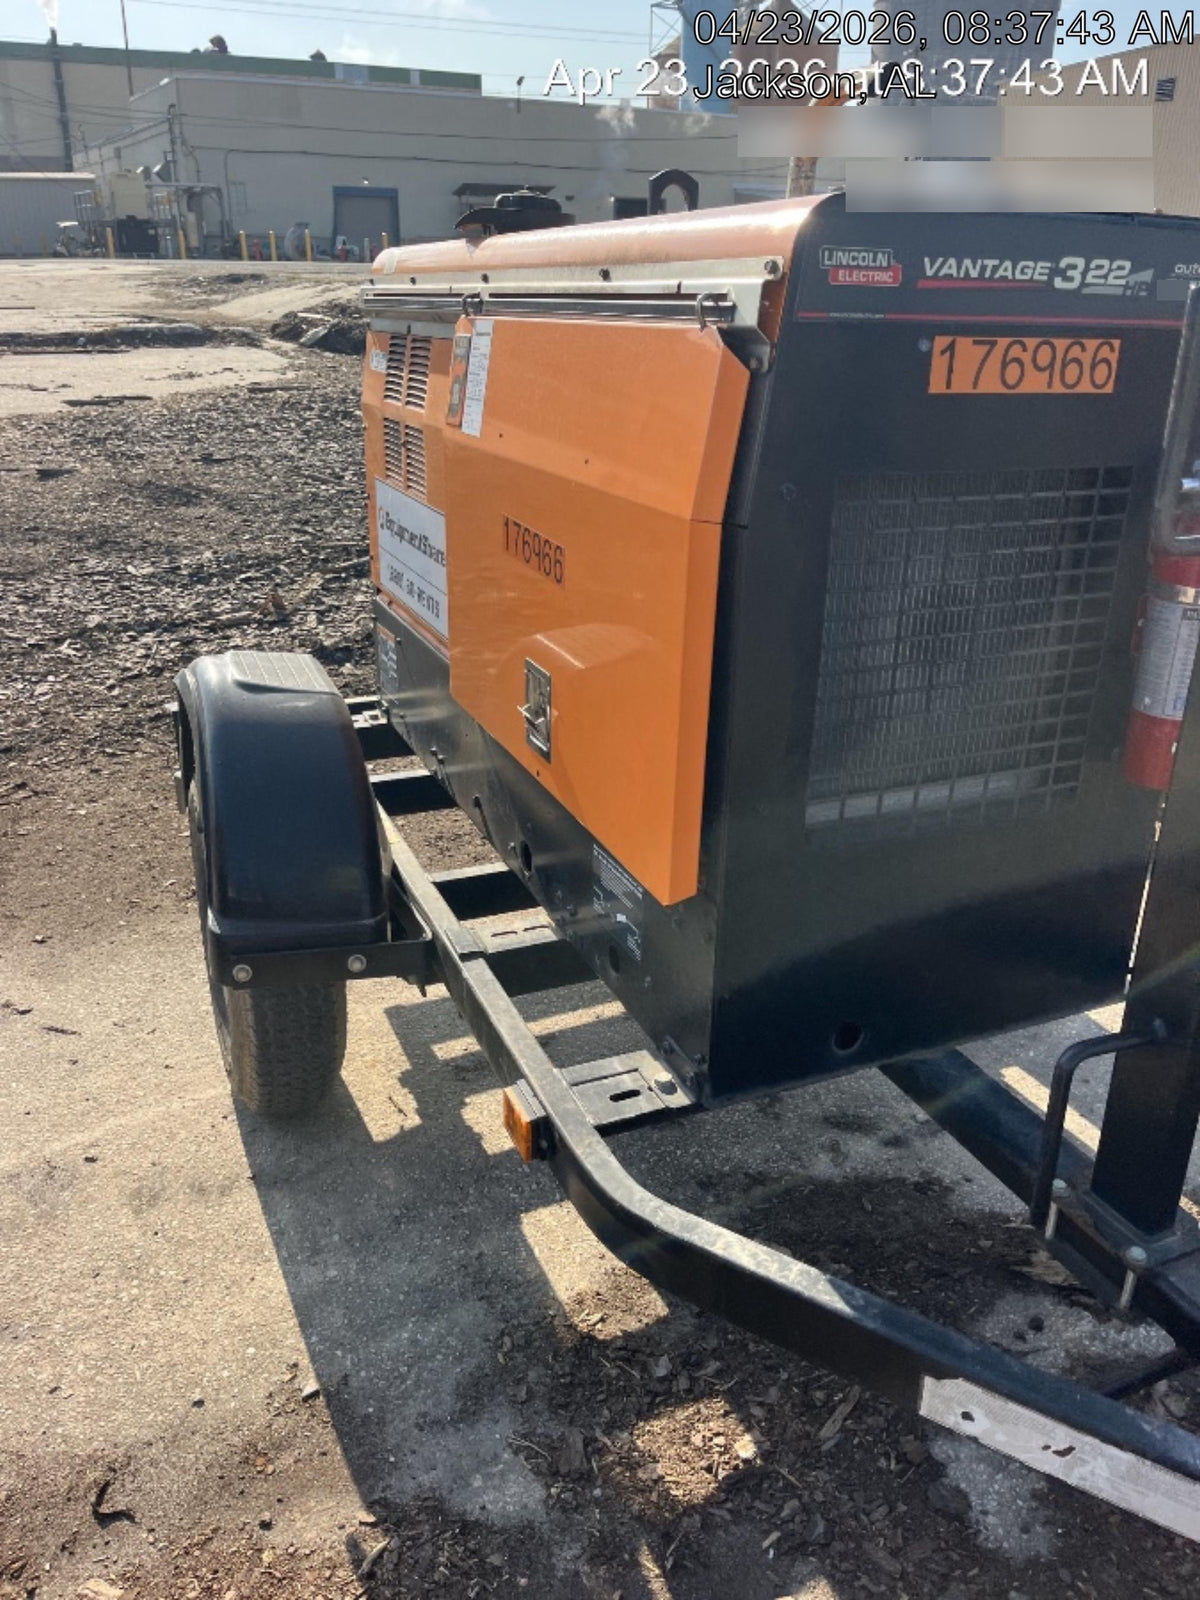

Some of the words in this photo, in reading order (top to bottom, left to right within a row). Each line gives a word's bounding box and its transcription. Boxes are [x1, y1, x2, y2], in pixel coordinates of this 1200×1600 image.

[824, 250, 888, 267] LINCOLN
[923, 257, 1052, 281] VANTAGE
[1054, 256, 1132, 290] 322
[838, 269, 894, 283] ELECTRIC
[940, 337, 1116, 390] 176966
[504, 516, 563, 583] 176966
